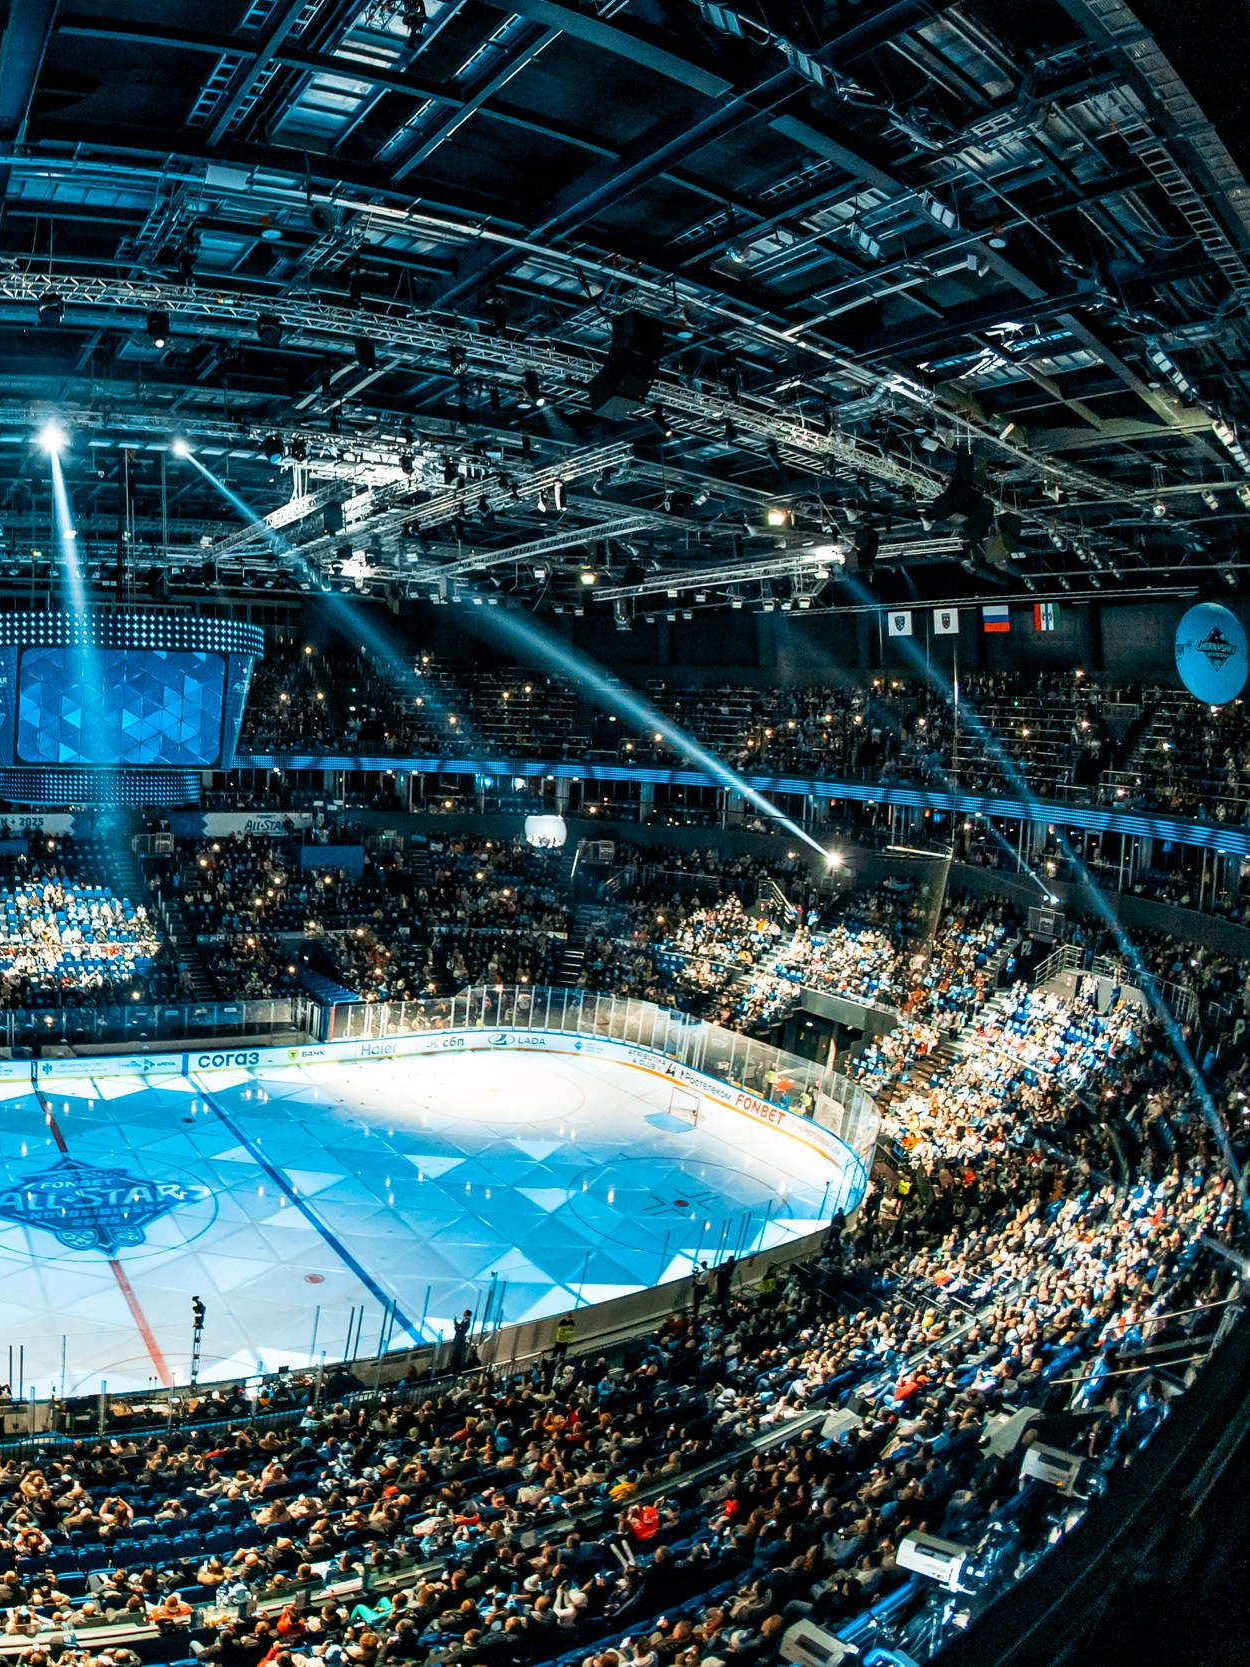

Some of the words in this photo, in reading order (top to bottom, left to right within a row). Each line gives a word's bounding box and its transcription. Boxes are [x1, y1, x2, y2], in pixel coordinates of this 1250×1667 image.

[19, 818, 44, 827] 2025
[517, 1037, 546, 1045] LADA
[361, 1043, 397, 1056] Haier
[735, 1093, 786, 1126] FONBET
[40, 1178, 115, 1189] FONBET
[28, 1204, 158, 1220] NOVOSIBIRSK
[71, 1216, 121, 1226] 2025
